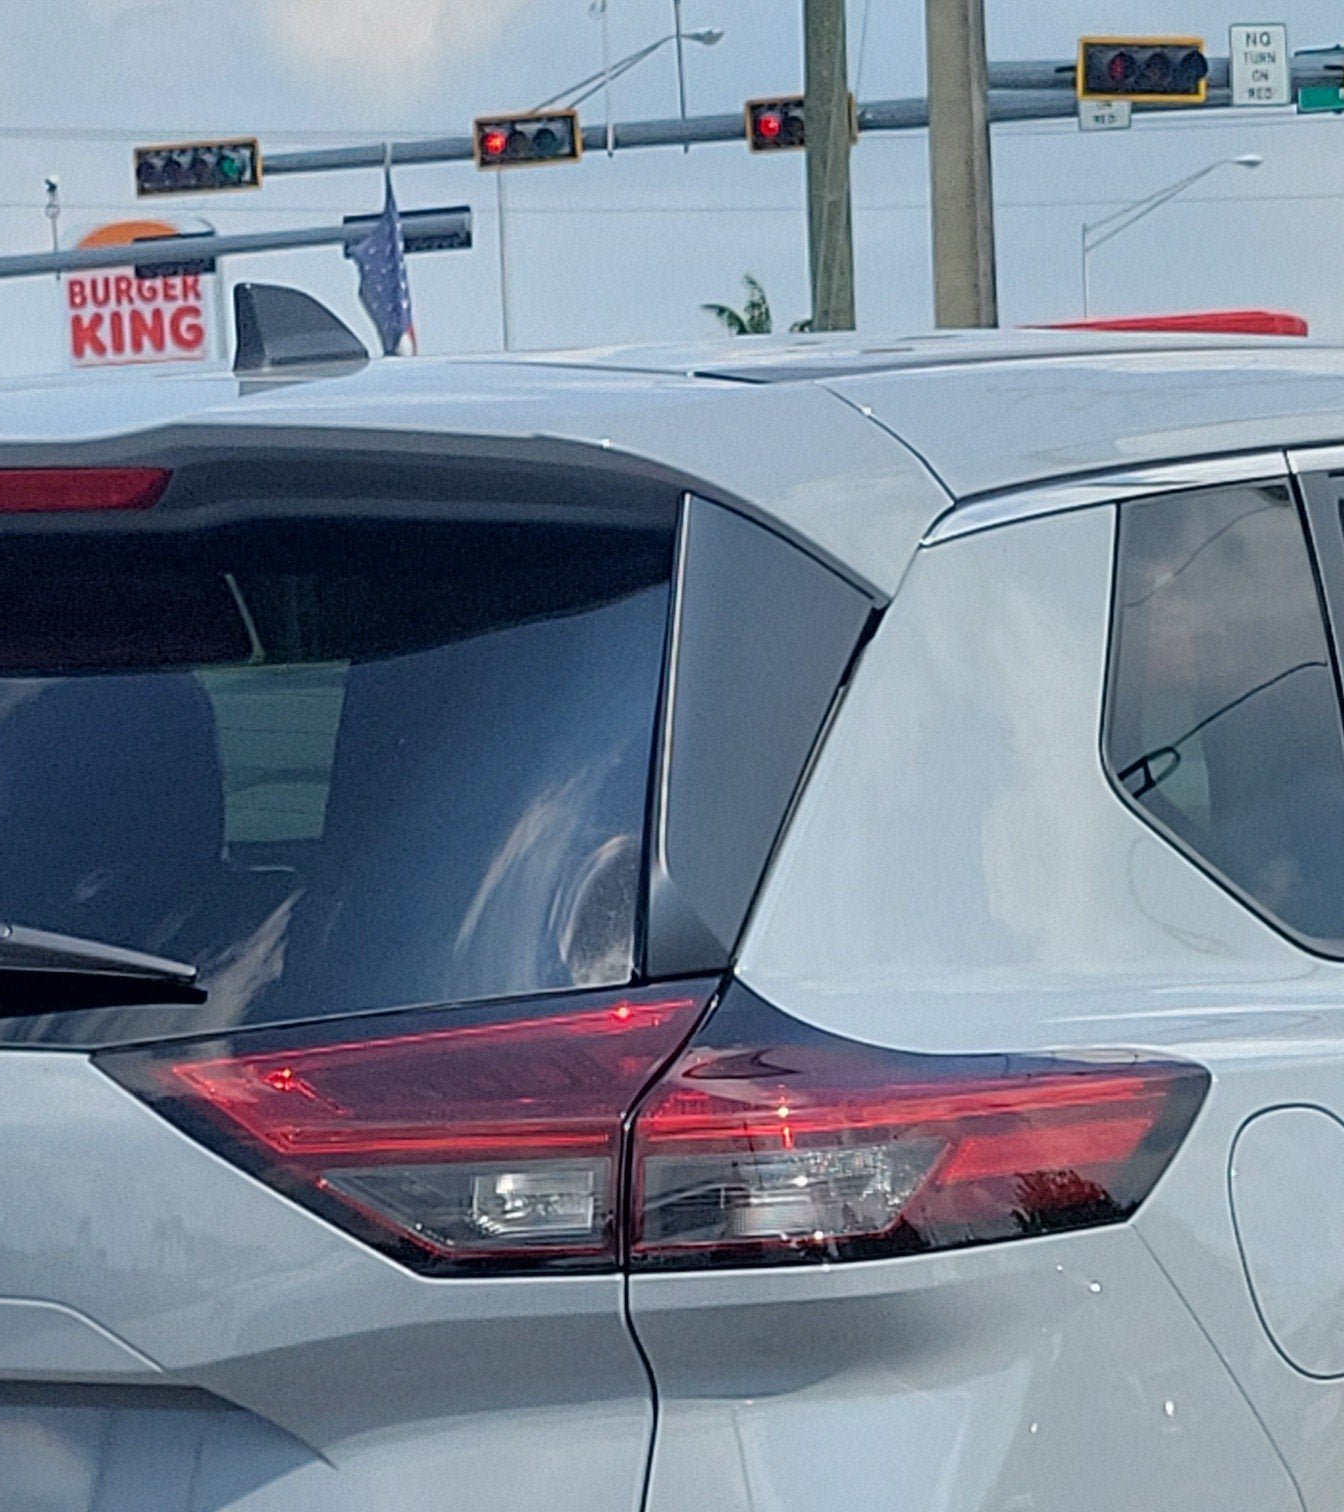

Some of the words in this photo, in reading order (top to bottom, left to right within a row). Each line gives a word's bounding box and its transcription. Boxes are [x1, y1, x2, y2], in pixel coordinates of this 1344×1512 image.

[1245, 31, 1271, 47] NO
[1243, 52, 1276, 65] TURN
[1251, 69, 1269, 82] ON
[1248, 87, 1272, 99] RED
[68, 271, 202, 310] BURGER
[71, 305, 204, 358] KING
